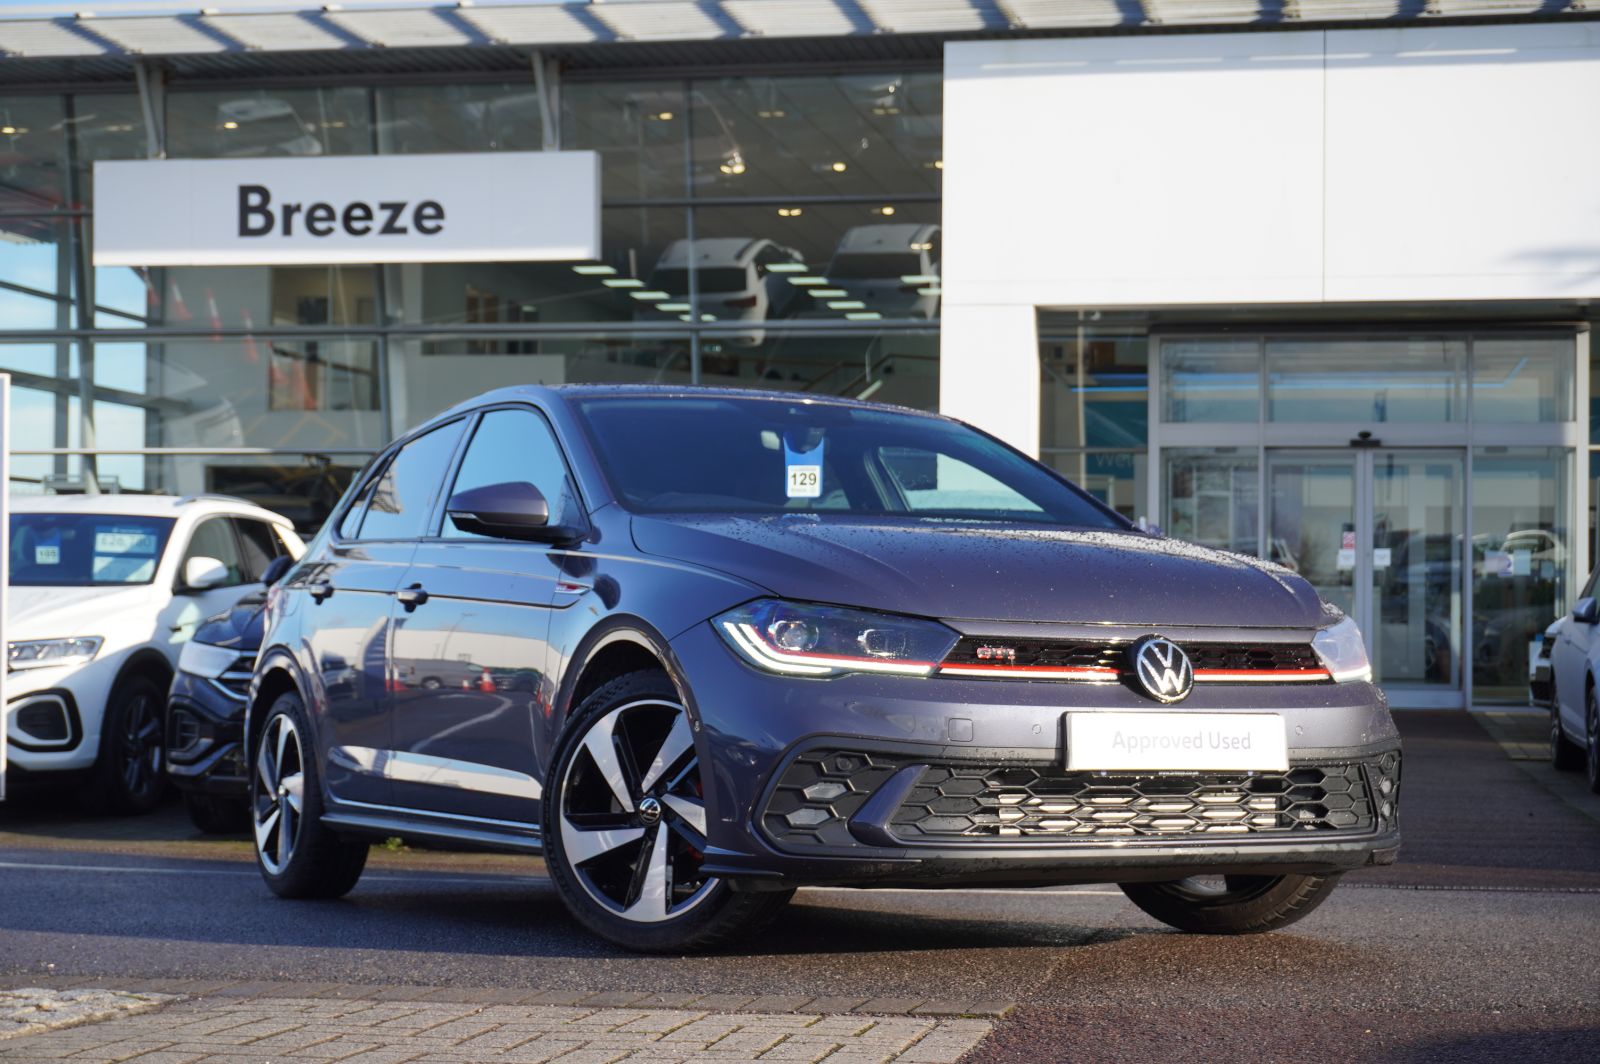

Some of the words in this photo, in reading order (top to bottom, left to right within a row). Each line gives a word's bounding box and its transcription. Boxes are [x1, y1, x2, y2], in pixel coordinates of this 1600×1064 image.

[238, 184, 446, 237] Breeze
[791, 472, 817, 486] 129
[1111, 730, 1203, 754] Approved
[1208, 730, 1251, 750] Used
